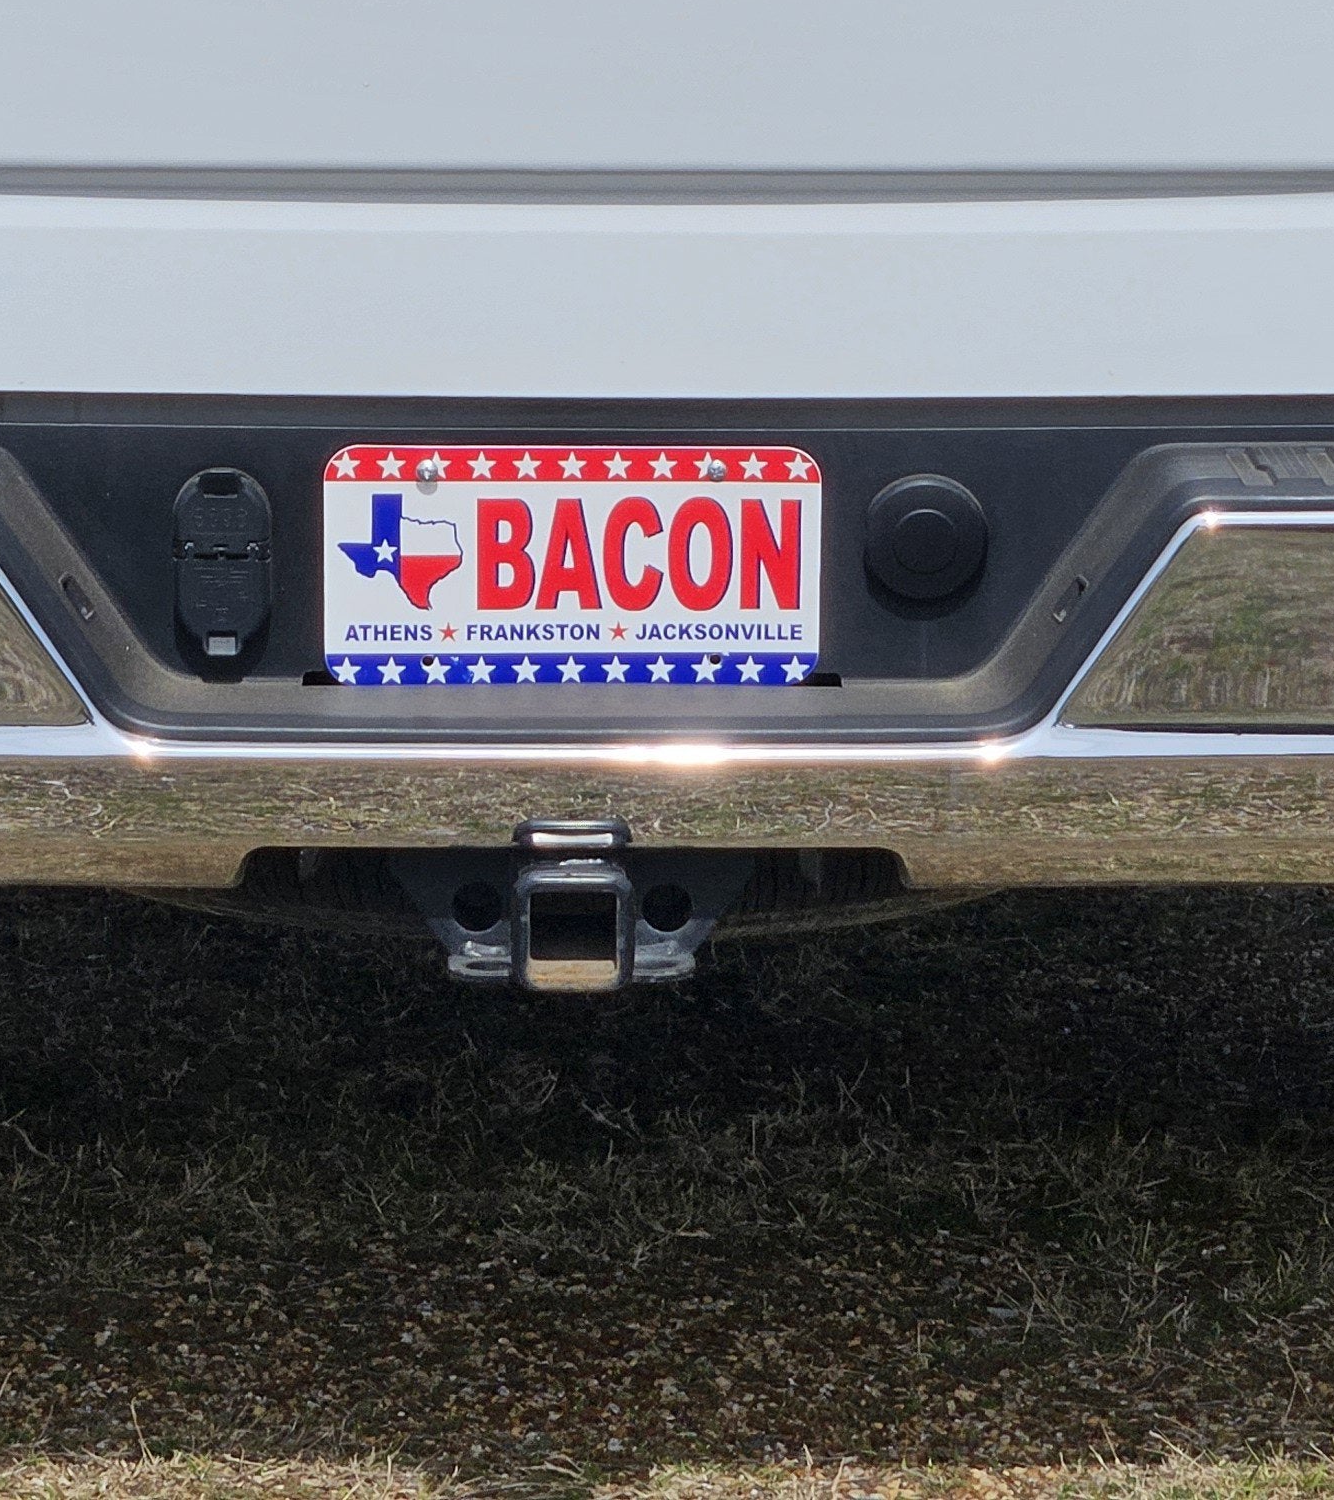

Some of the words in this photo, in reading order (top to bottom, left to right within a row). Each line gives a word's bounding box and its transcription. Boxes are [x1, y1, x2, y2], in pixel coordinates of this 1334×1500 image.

[476, 496, 803, 612] BACON
[344, 624, 433, 643] ATHENS
[466, 622, 601, 643] FRANKSTON
[635, 622, 803, 643] JACKSONVILLE
